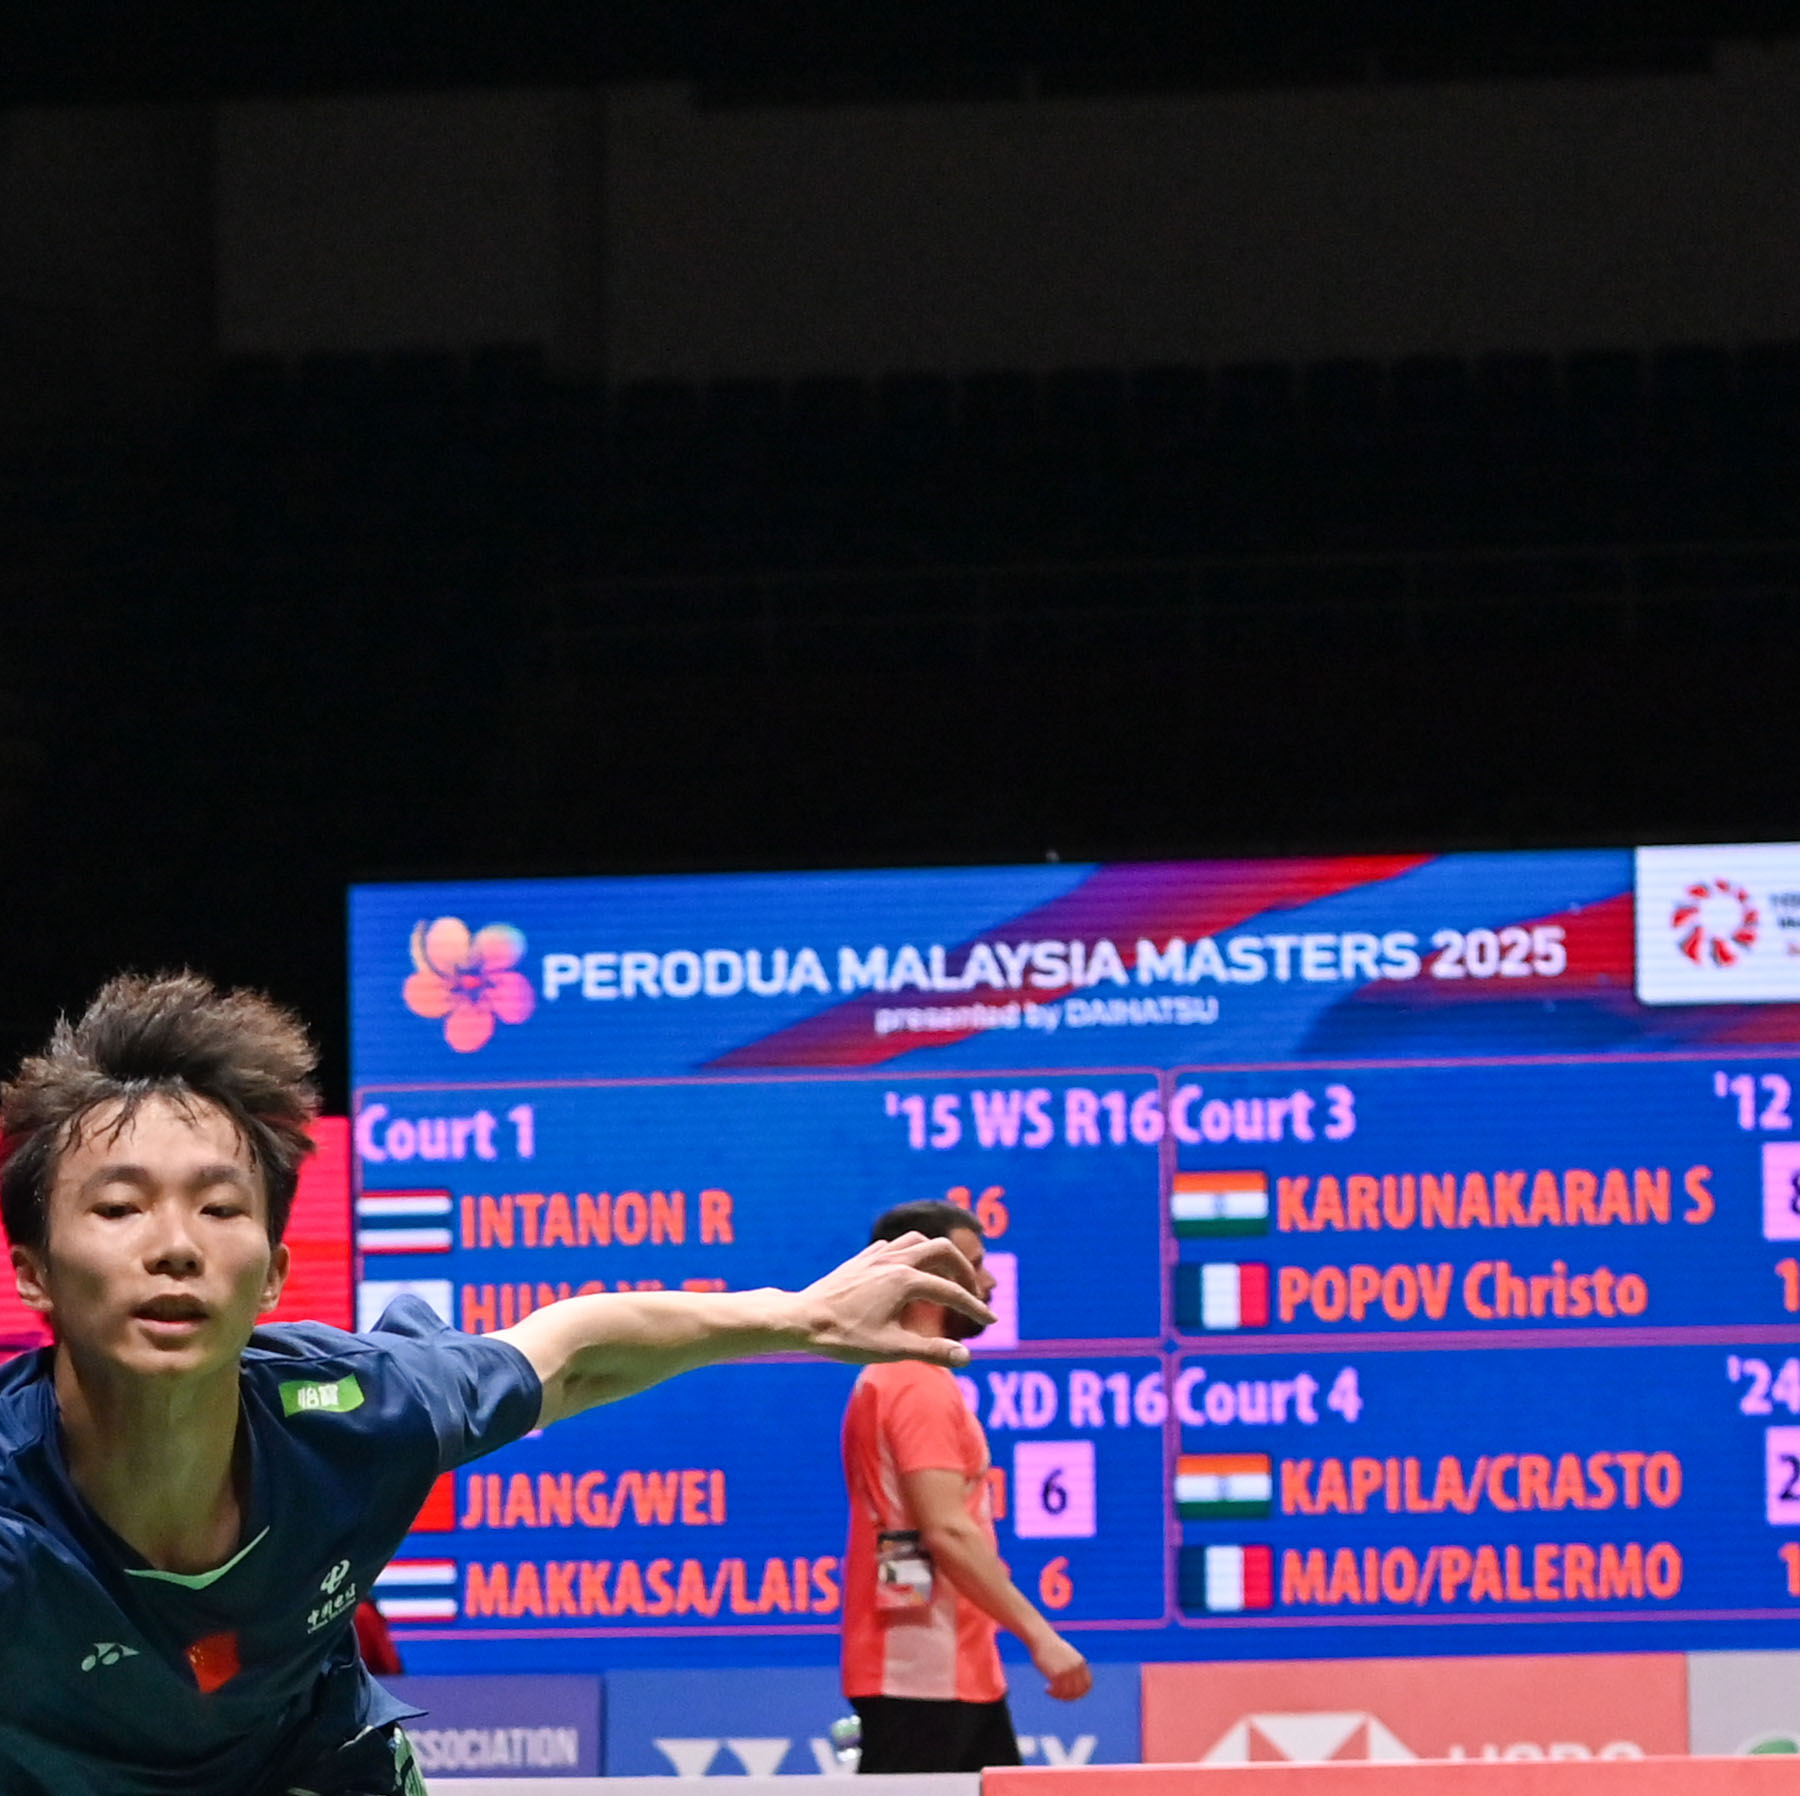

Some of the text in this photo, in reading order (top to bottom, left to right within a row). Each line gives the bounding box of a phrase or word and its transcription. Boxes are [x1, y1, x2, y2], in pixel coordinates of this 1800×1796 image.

[543, 925, 1568, 1000] PERODUA MALAYSIA MASTERS 2025
[875, 995, 1218, 1037] presented by DAIHATSU
[353, 1102, 535, 1162] Court 1
[884, 1086, 1165, 1150] '15 WS R16
[1170, 1085, 1357, 1144] Court 3
[1713, 1072, 1792, 1131] '12
[459, 1190, 686, 1249] INTANON
[698, 1188, 736, 1245] R
[1277, 1167, 1671, 1234] KARUNAKARAN
[1683, 1164, 1716, 1226] S
[1277, 1263, 1454, 1324] POPOV
[1463, 1260, 1648, 1319] Christo
[987, 1370, 1058, 1429] XD
[1067, 1369, 1169, 1428] R16
[1174, 1367, 1363, 1427] Court 4
[461, 1466, 726, 1531] JIANG/WEI
[1042, 1467, 1067, 1516] 6
[1280, 1449, 1684, 1515] KAPILA/CRASTO
[464, 1555, 1073, 1619] MAKKASA/LAIS 6
[1280, 1541, 1684, 1607] MAIO/PALERMO
[405, 1727, 579, 1770] SSOCIATION
